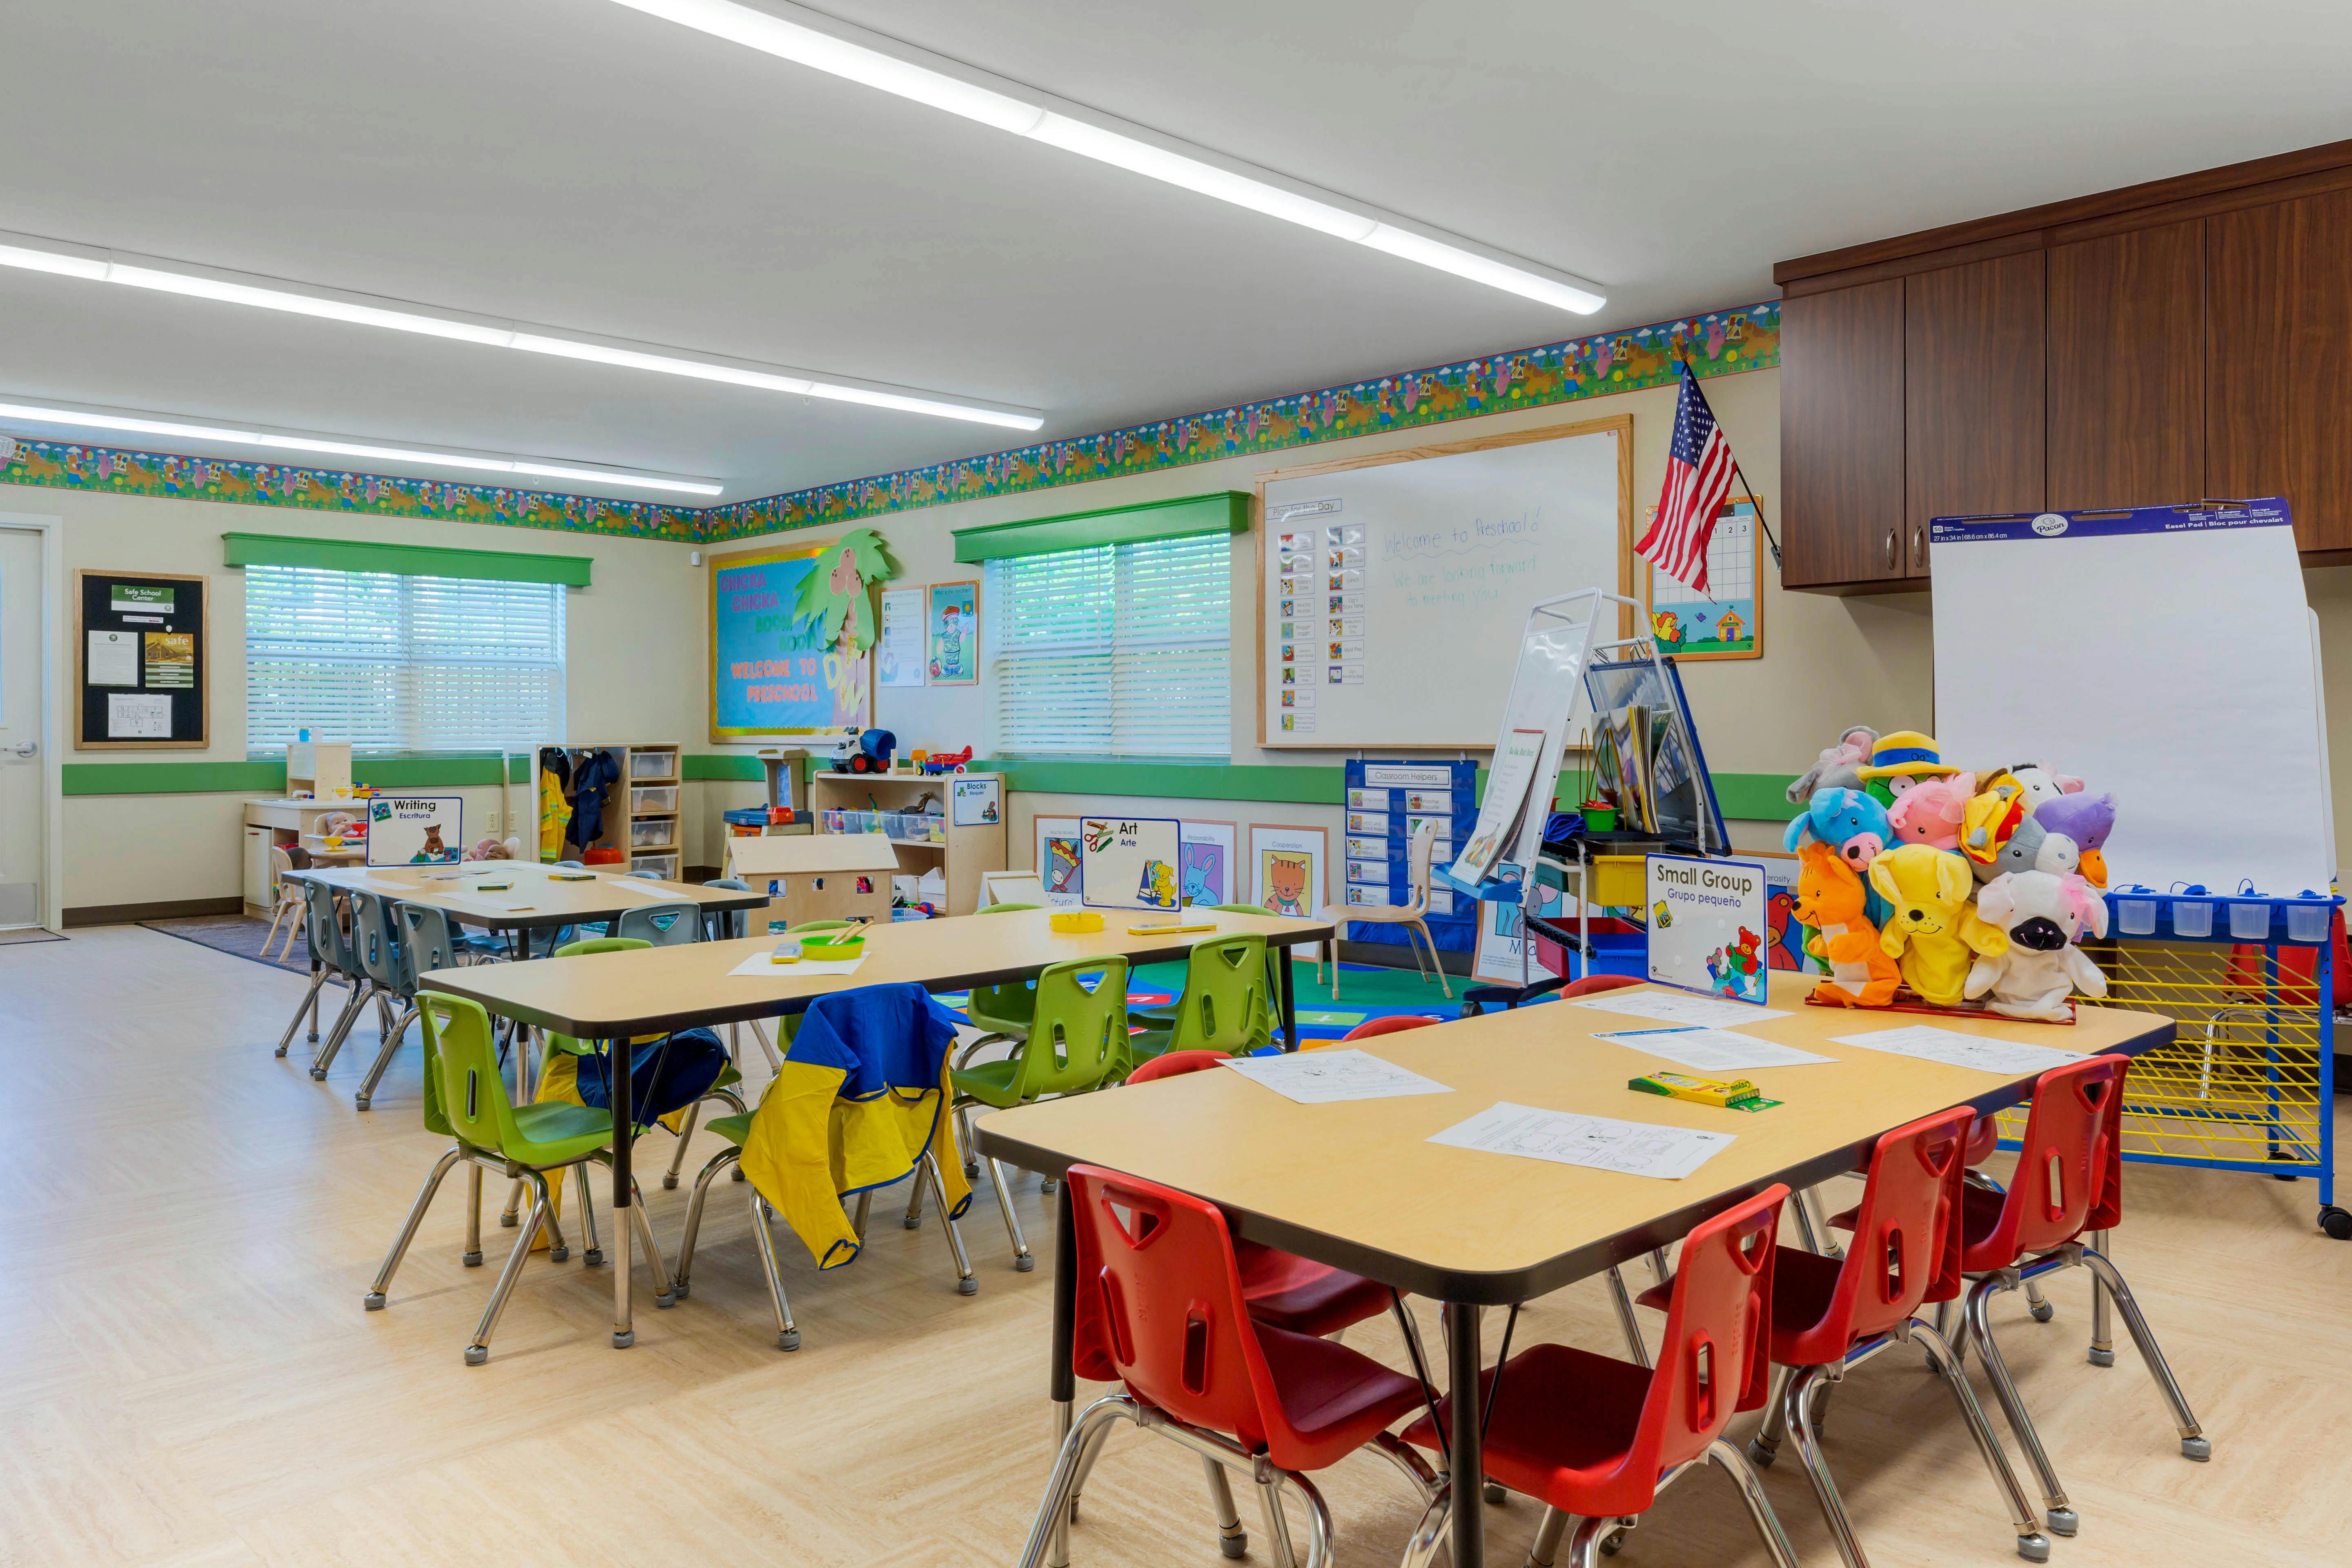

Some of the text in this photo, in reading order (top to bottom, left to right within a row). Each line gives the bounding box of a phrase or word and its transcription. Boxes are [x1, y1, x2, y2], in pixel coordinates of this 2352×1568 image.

[1273, 508, 1289, 517] Plan
[1303, 503, 1315, 512] the
[1318, 502, 1335, 511] Day
[2036, 523, 2065, 533] Pacon
[1383, 532, 1441, 554] Welcome
[1450, 526, 1469, 543] to
[1392, 551, 1537, 588] We are looking forward
[719, 570, 766, 593] CHICKA
[732, 591, 779, 612] CHICKA
[1405, 590, 1465, 611] to meeting
[756, 614, 793, 633] BOOM
[165, 636, 189, 646] safe
[731, 659, 791, 680] WELCOME
[799, 657, 817, 677] TO
[746, 683, 818, 703] PRESCHOOL
[1375, 771, 1437, 781] Classroom Helpers
[394, 800, 436, 812] Writing
[1119, 822, 1138, 835] Art
[1120, 838, 1137, 846] Arte
[1187, 834, 1215, 842] Responsibility
[1657, 864, 1753, 896] Small Group
[1766, 875, 1791, 884] erosity
[1667, 888, 1742, 908] Grupo pequeño
[1509, 939, 1537, 956] Ma
[1730, 1080, 1752, 1092] Crayola
